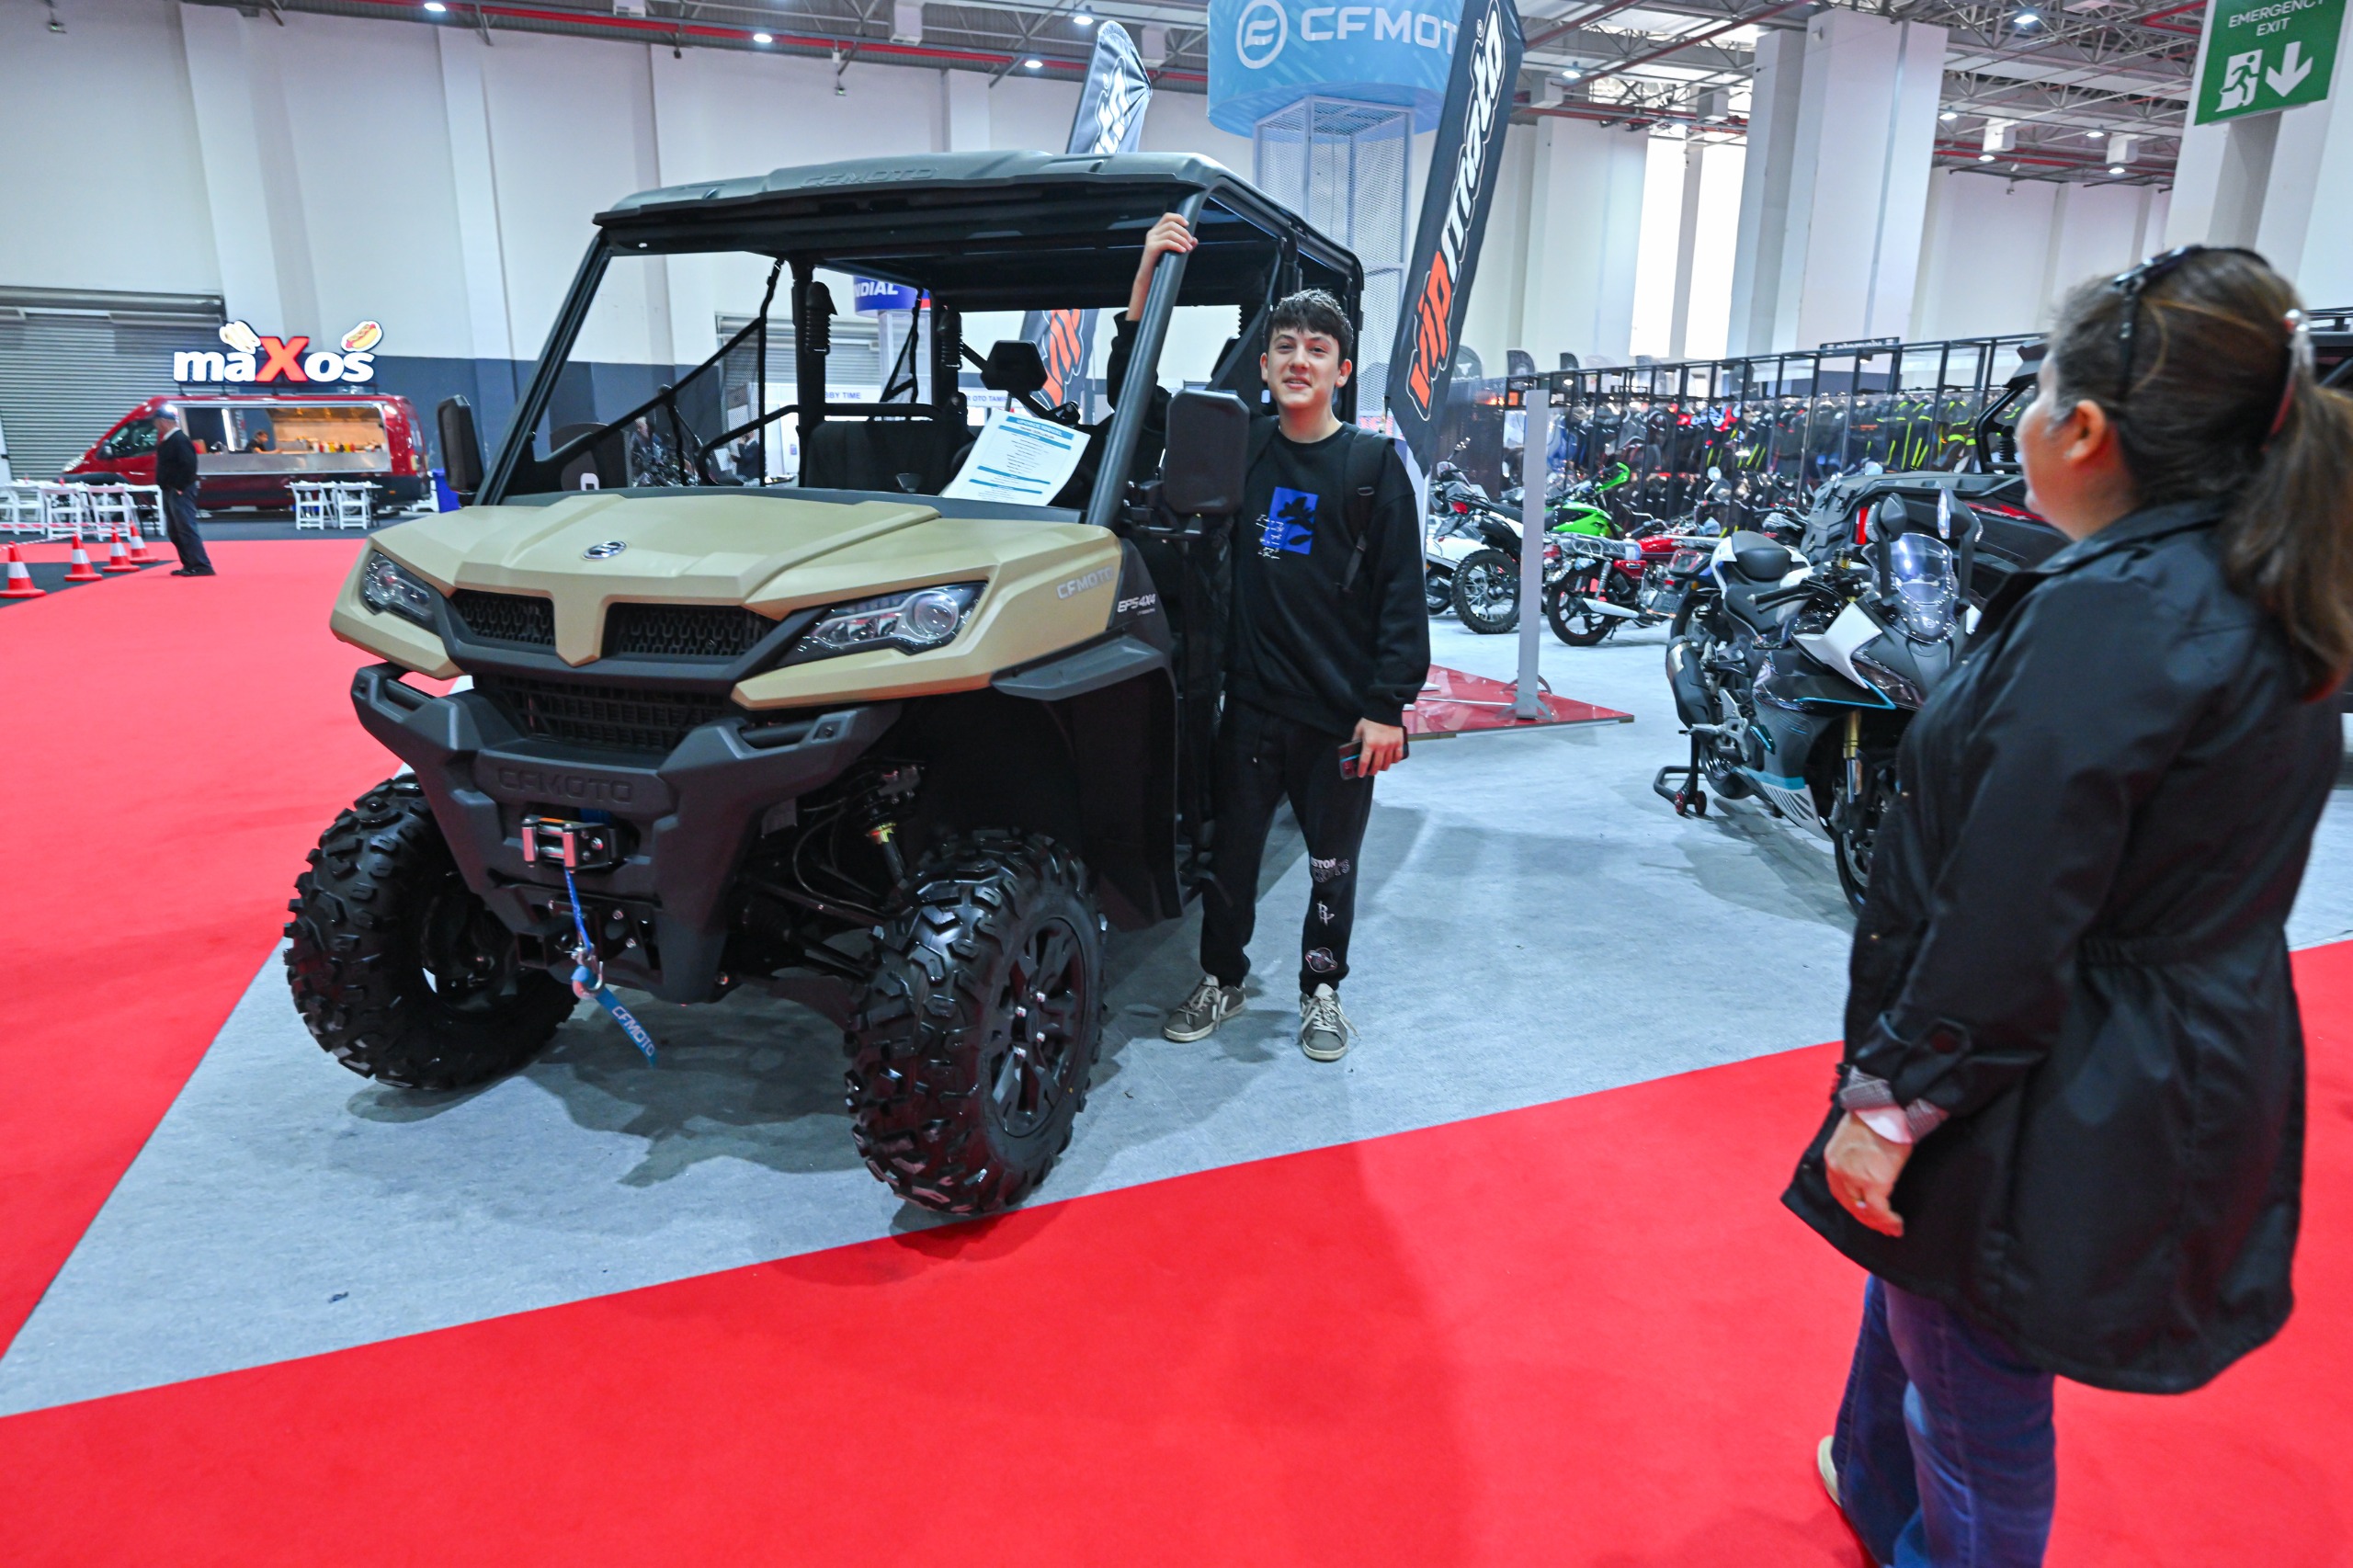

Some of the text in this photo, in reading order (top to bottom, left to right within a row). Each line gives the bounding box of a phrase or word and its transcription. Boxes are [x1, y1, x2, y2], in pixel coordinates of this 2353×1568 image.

[2256, 17, 2291, 37] EXIT
[843, 392, 861, 400] TIME
[1056, 565, 1114, 600] CFMOTO
[1117, 597, 1140, 613] EPS
[499, 767, 633, 805] CFMOTO
[611, 1006, 655, 1057] CFMOTO
